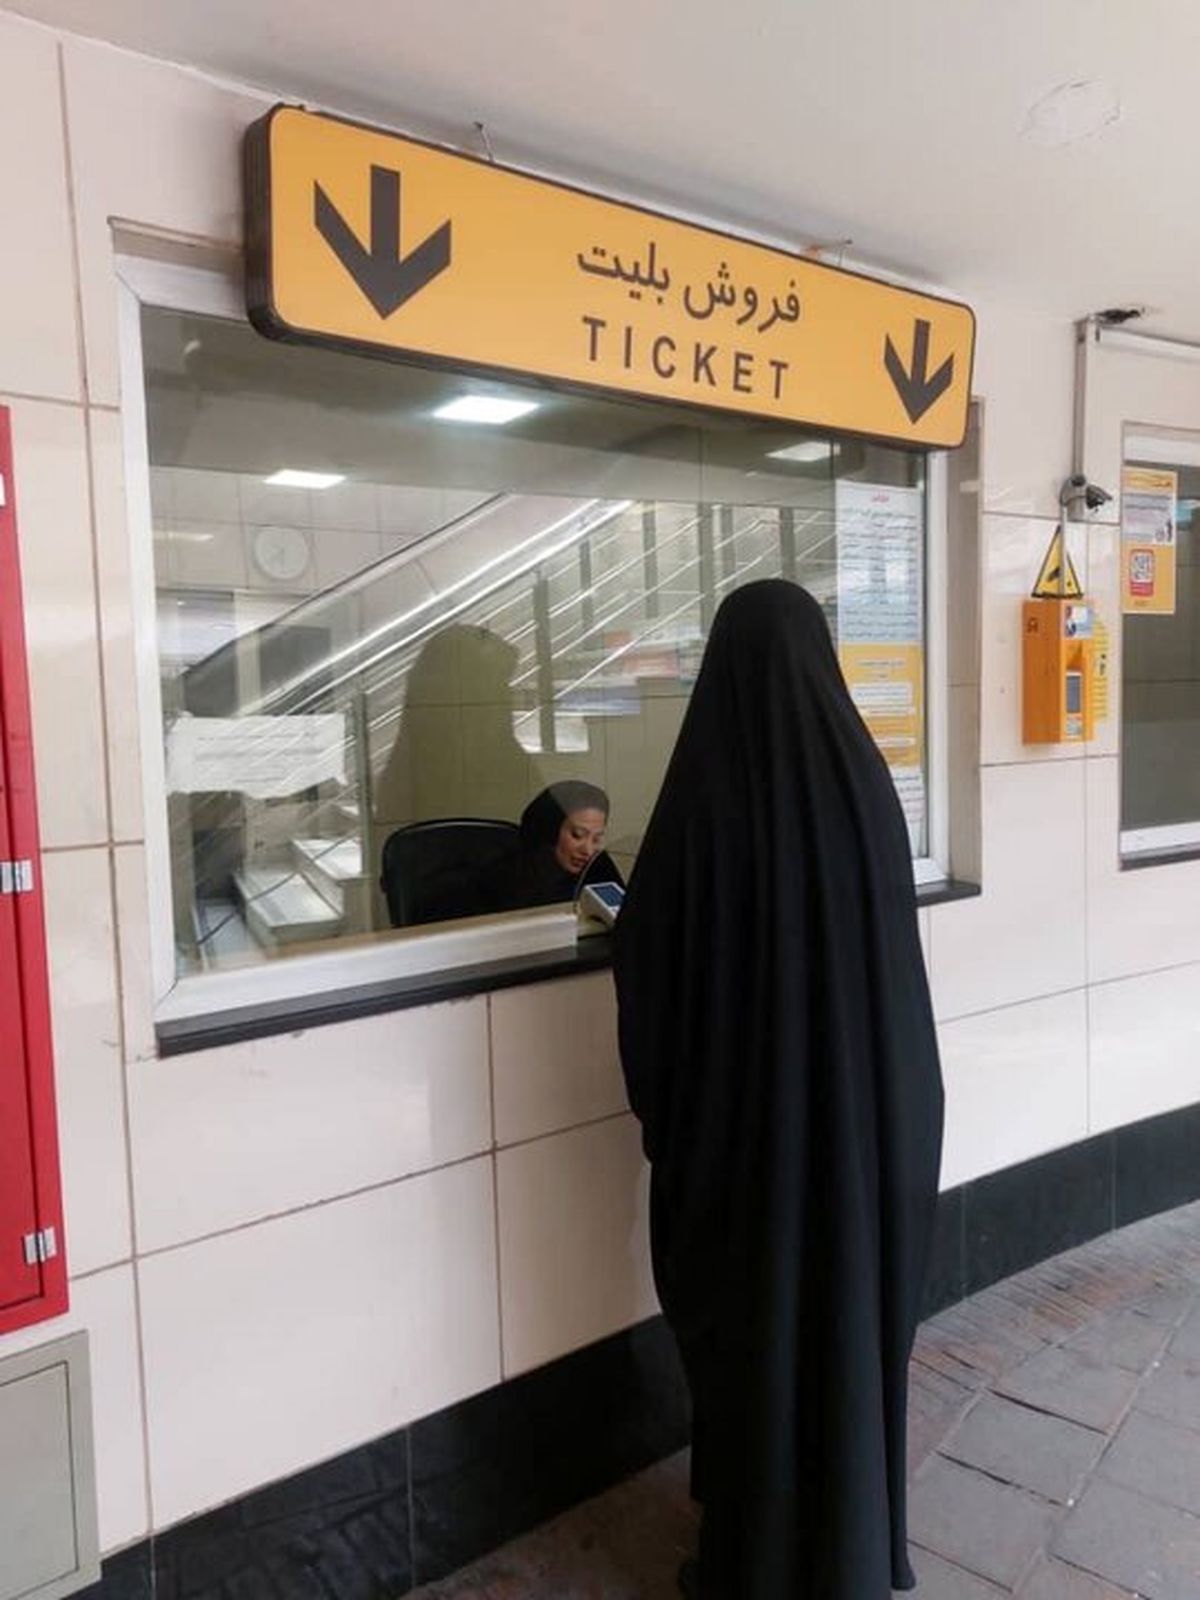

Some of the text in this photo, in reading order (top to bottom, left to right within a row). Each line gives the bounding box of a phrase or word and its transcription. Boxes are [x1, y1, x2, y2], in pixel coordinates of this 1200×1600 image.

[577, 241, 800, 333] فروش بلیت
[582, 315, 789, 400] TICKET
